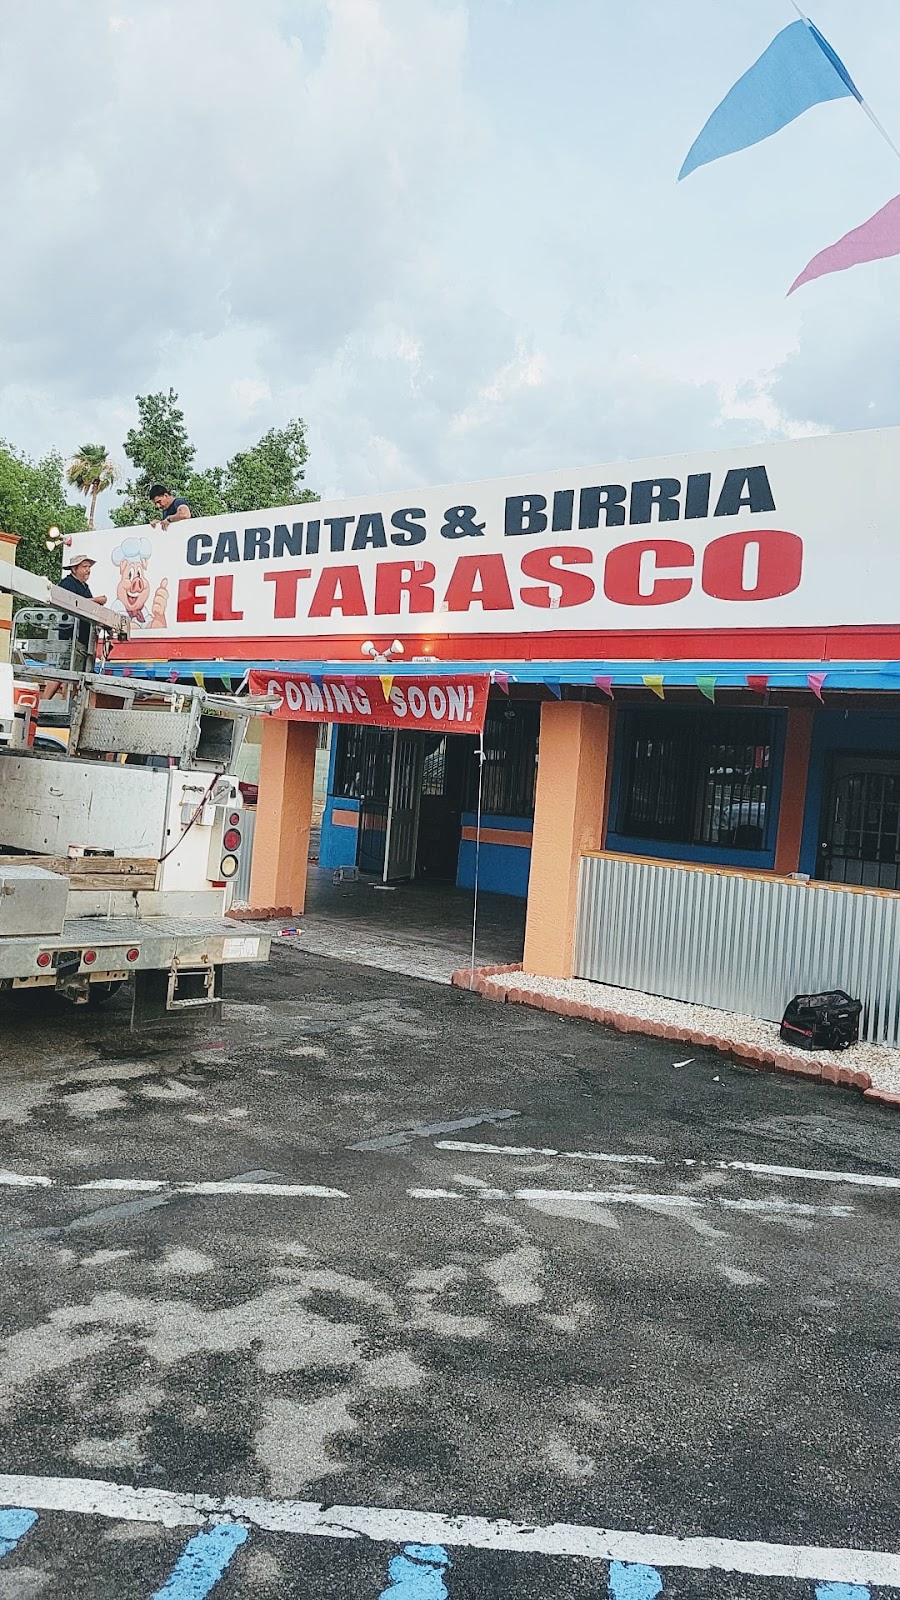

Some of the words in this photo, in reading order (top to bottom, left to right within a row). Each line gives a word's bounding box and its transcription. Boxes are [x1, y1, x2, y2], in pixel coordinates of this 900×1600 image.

[186, 507, 427, 566] CARNITAS
[440, 505, 486, 539] &
[504, 465, 776, 536] BIRRIA
[176, 574, 244, 623] EL
[264, 530, 803, 619] TARASCO
[267, 680, 372, 715] COMING
[390, 685, 474, 722] SOON!
